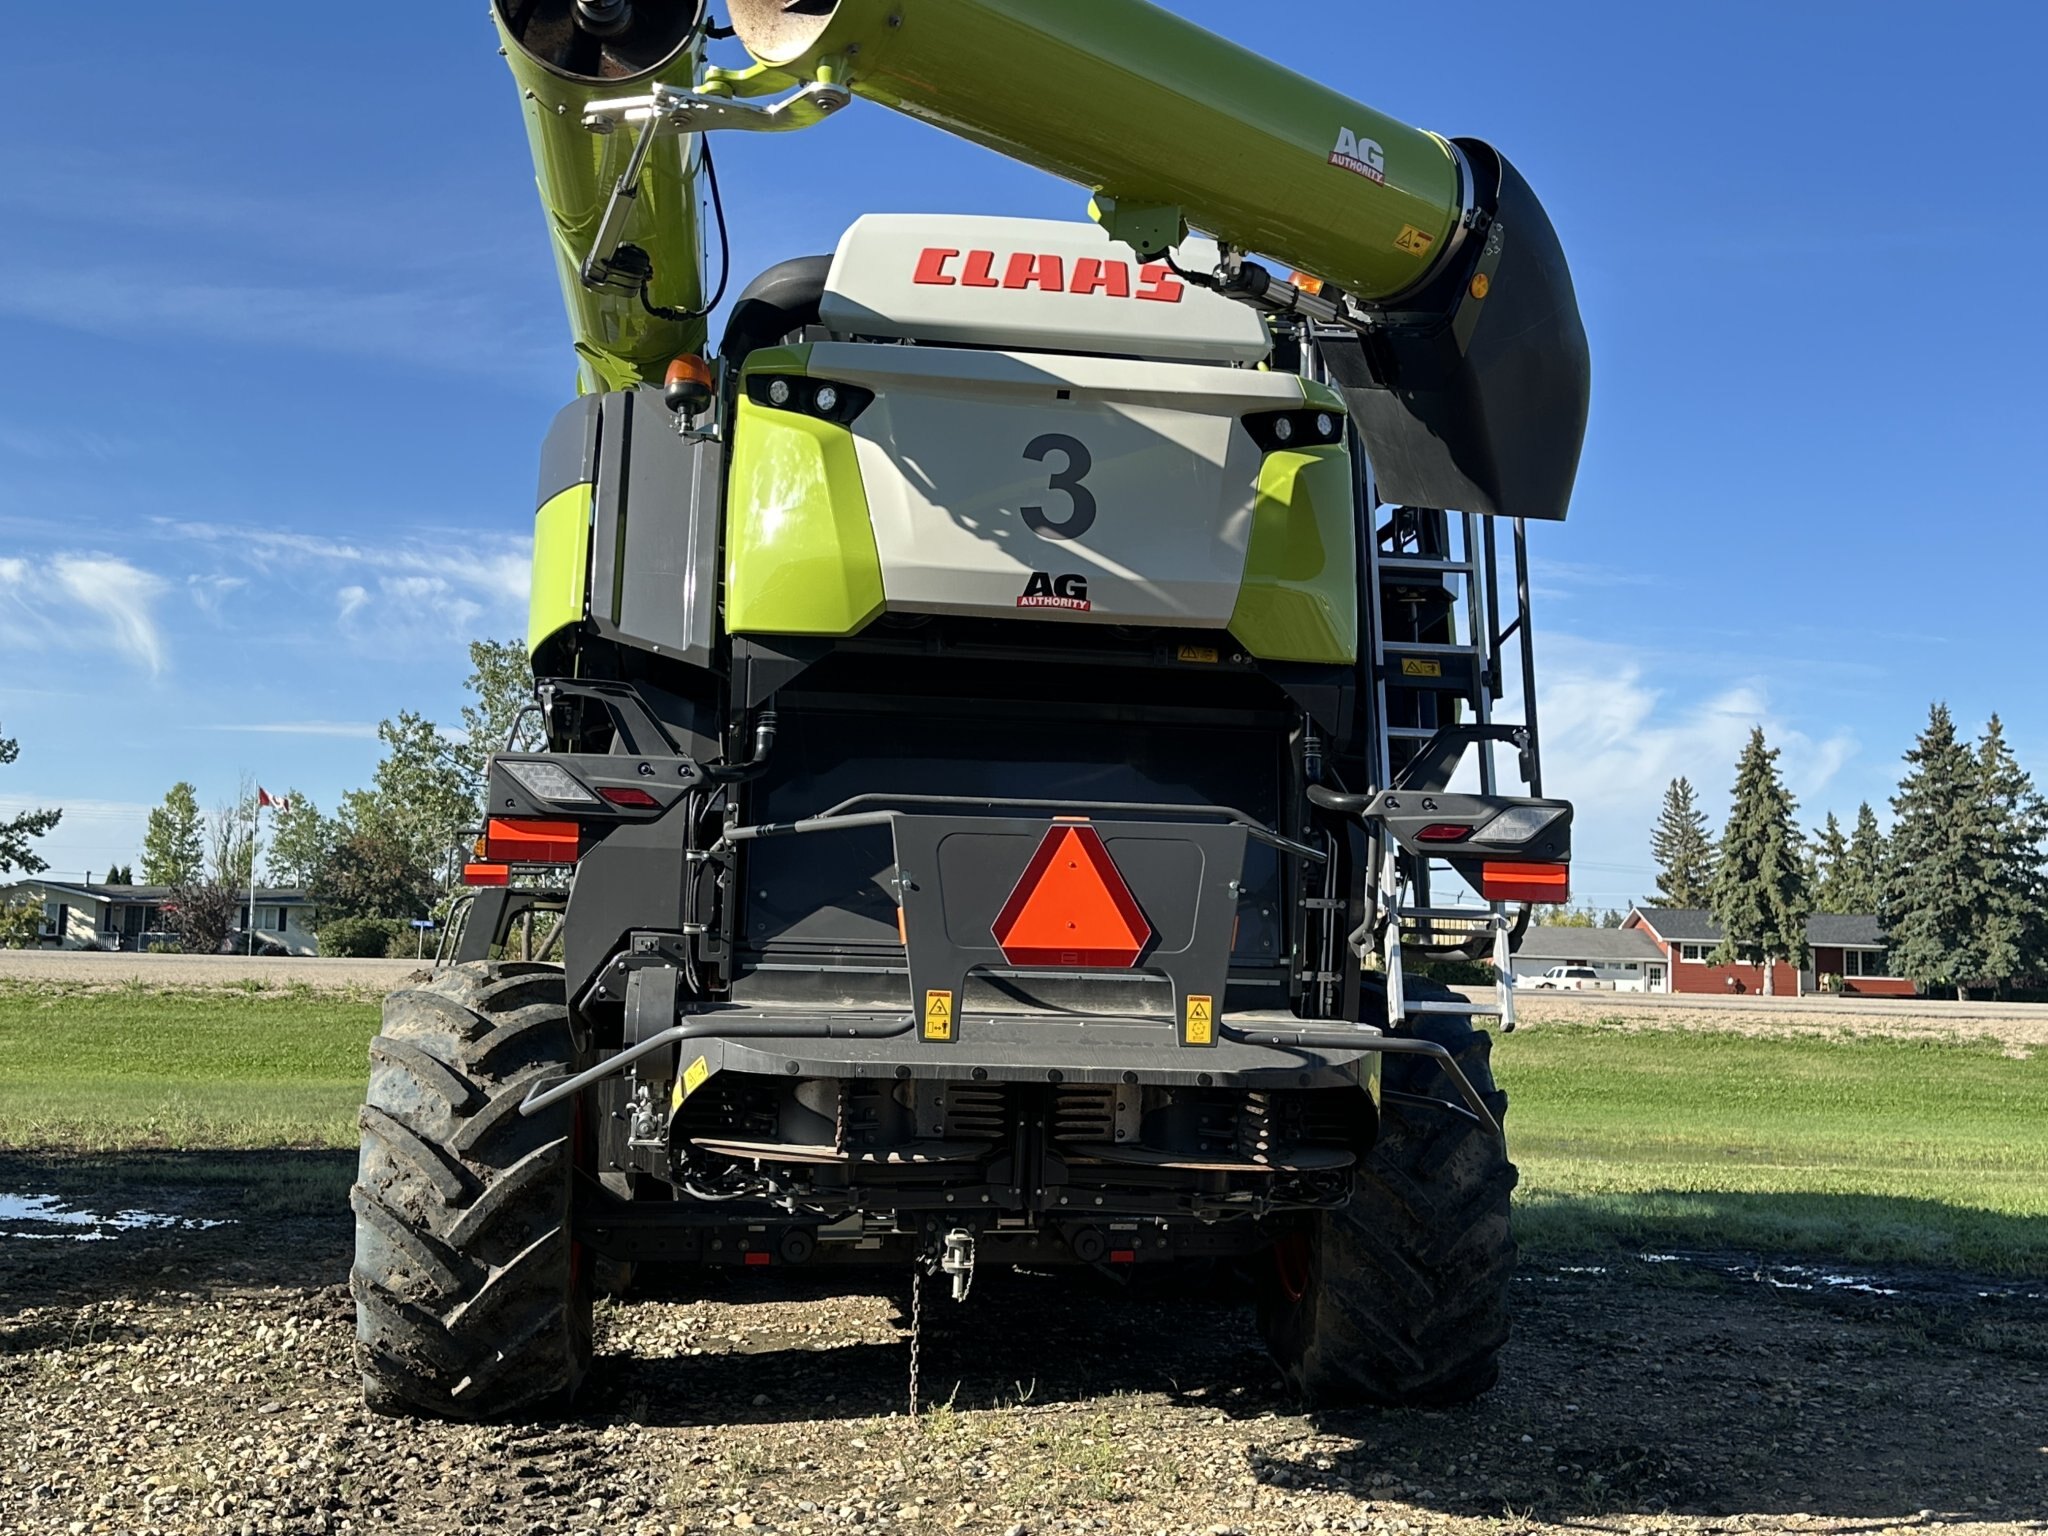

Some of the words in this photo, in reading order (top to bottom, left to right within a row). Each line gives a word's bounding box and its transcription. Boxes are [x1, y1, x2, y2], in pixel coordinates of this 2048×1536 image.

[1331, 153, 1384, 183] AUTHORITY
[1333, 126, 1384, 173] AG
[914, 247, 1184, 302] CLAAS
[1020, 433, 1096, 540] 3
[1021, 596, 1087, 609] AUTHORITY
[1022, 571, 1088, 600] AG
